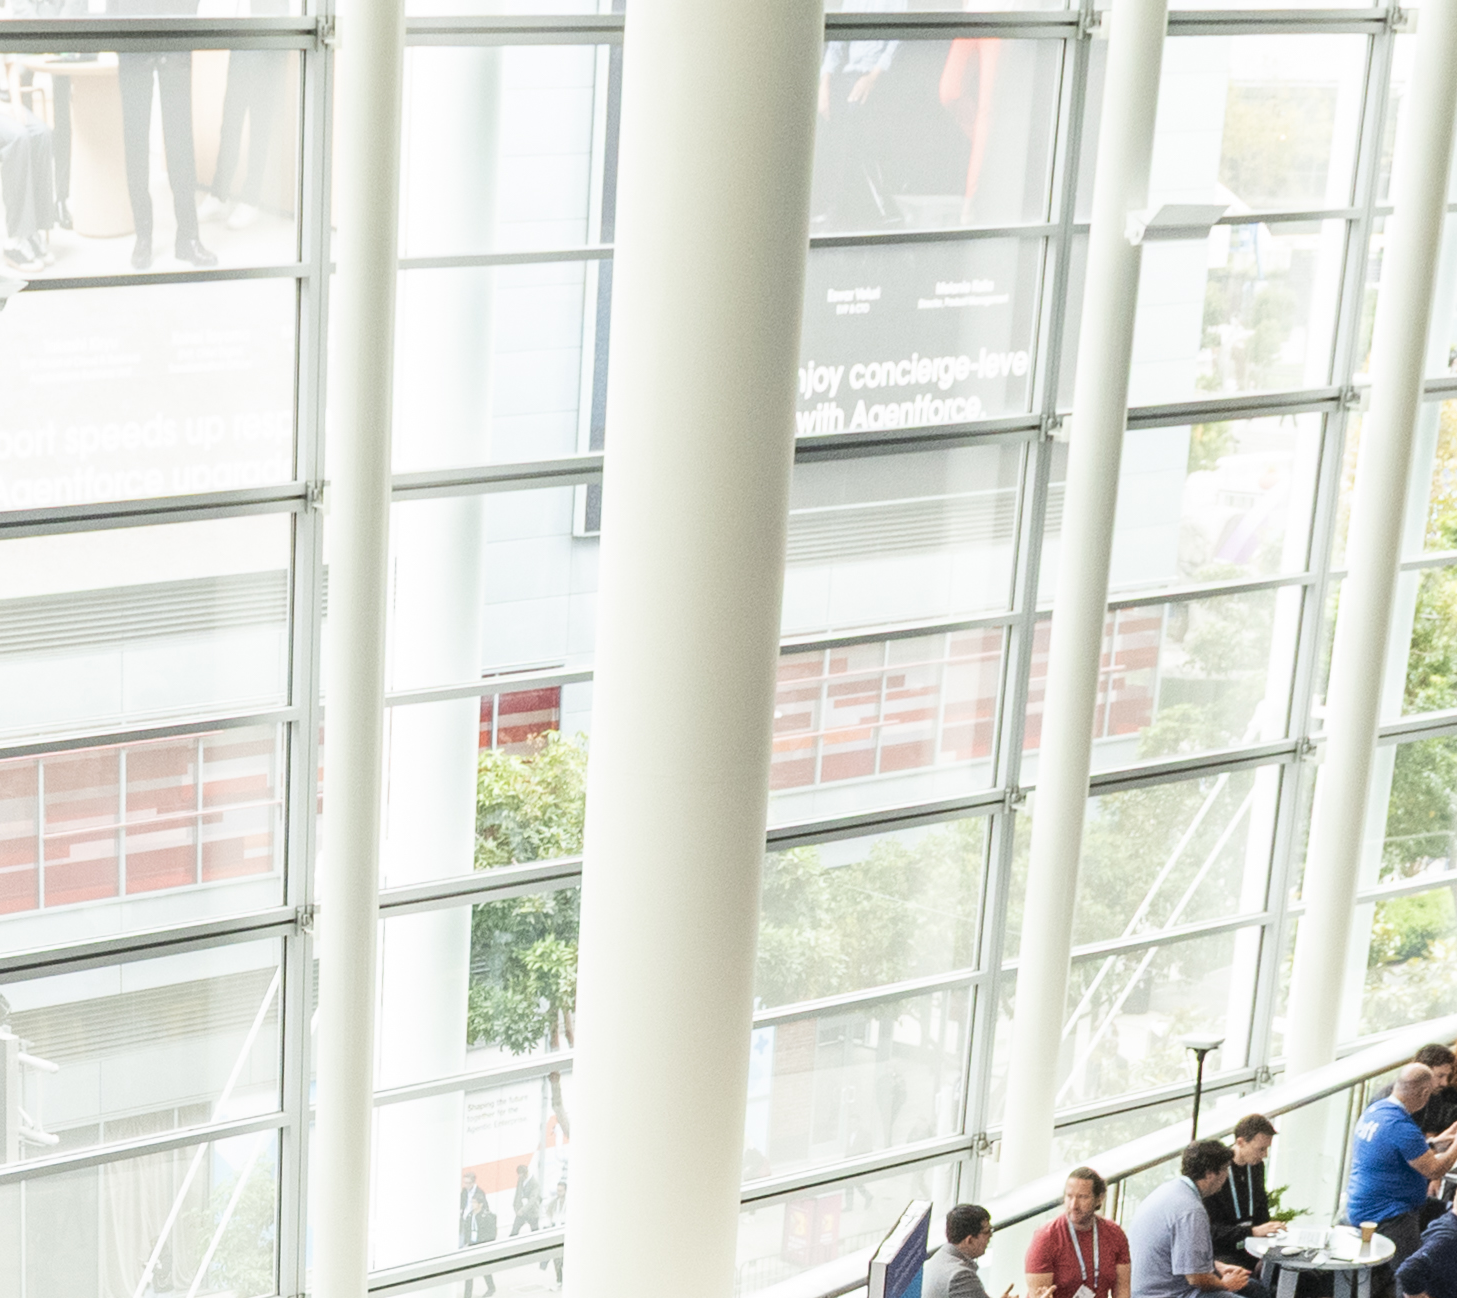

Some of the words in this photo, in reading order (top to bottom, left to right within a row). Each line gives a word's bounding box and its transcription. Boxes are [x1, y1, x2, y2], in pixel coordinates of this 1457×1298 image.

[849, 349, 1029, 390] concierge-leve
[64, 412, 178, 461] speeds
[185, 415, 226, 451] up
